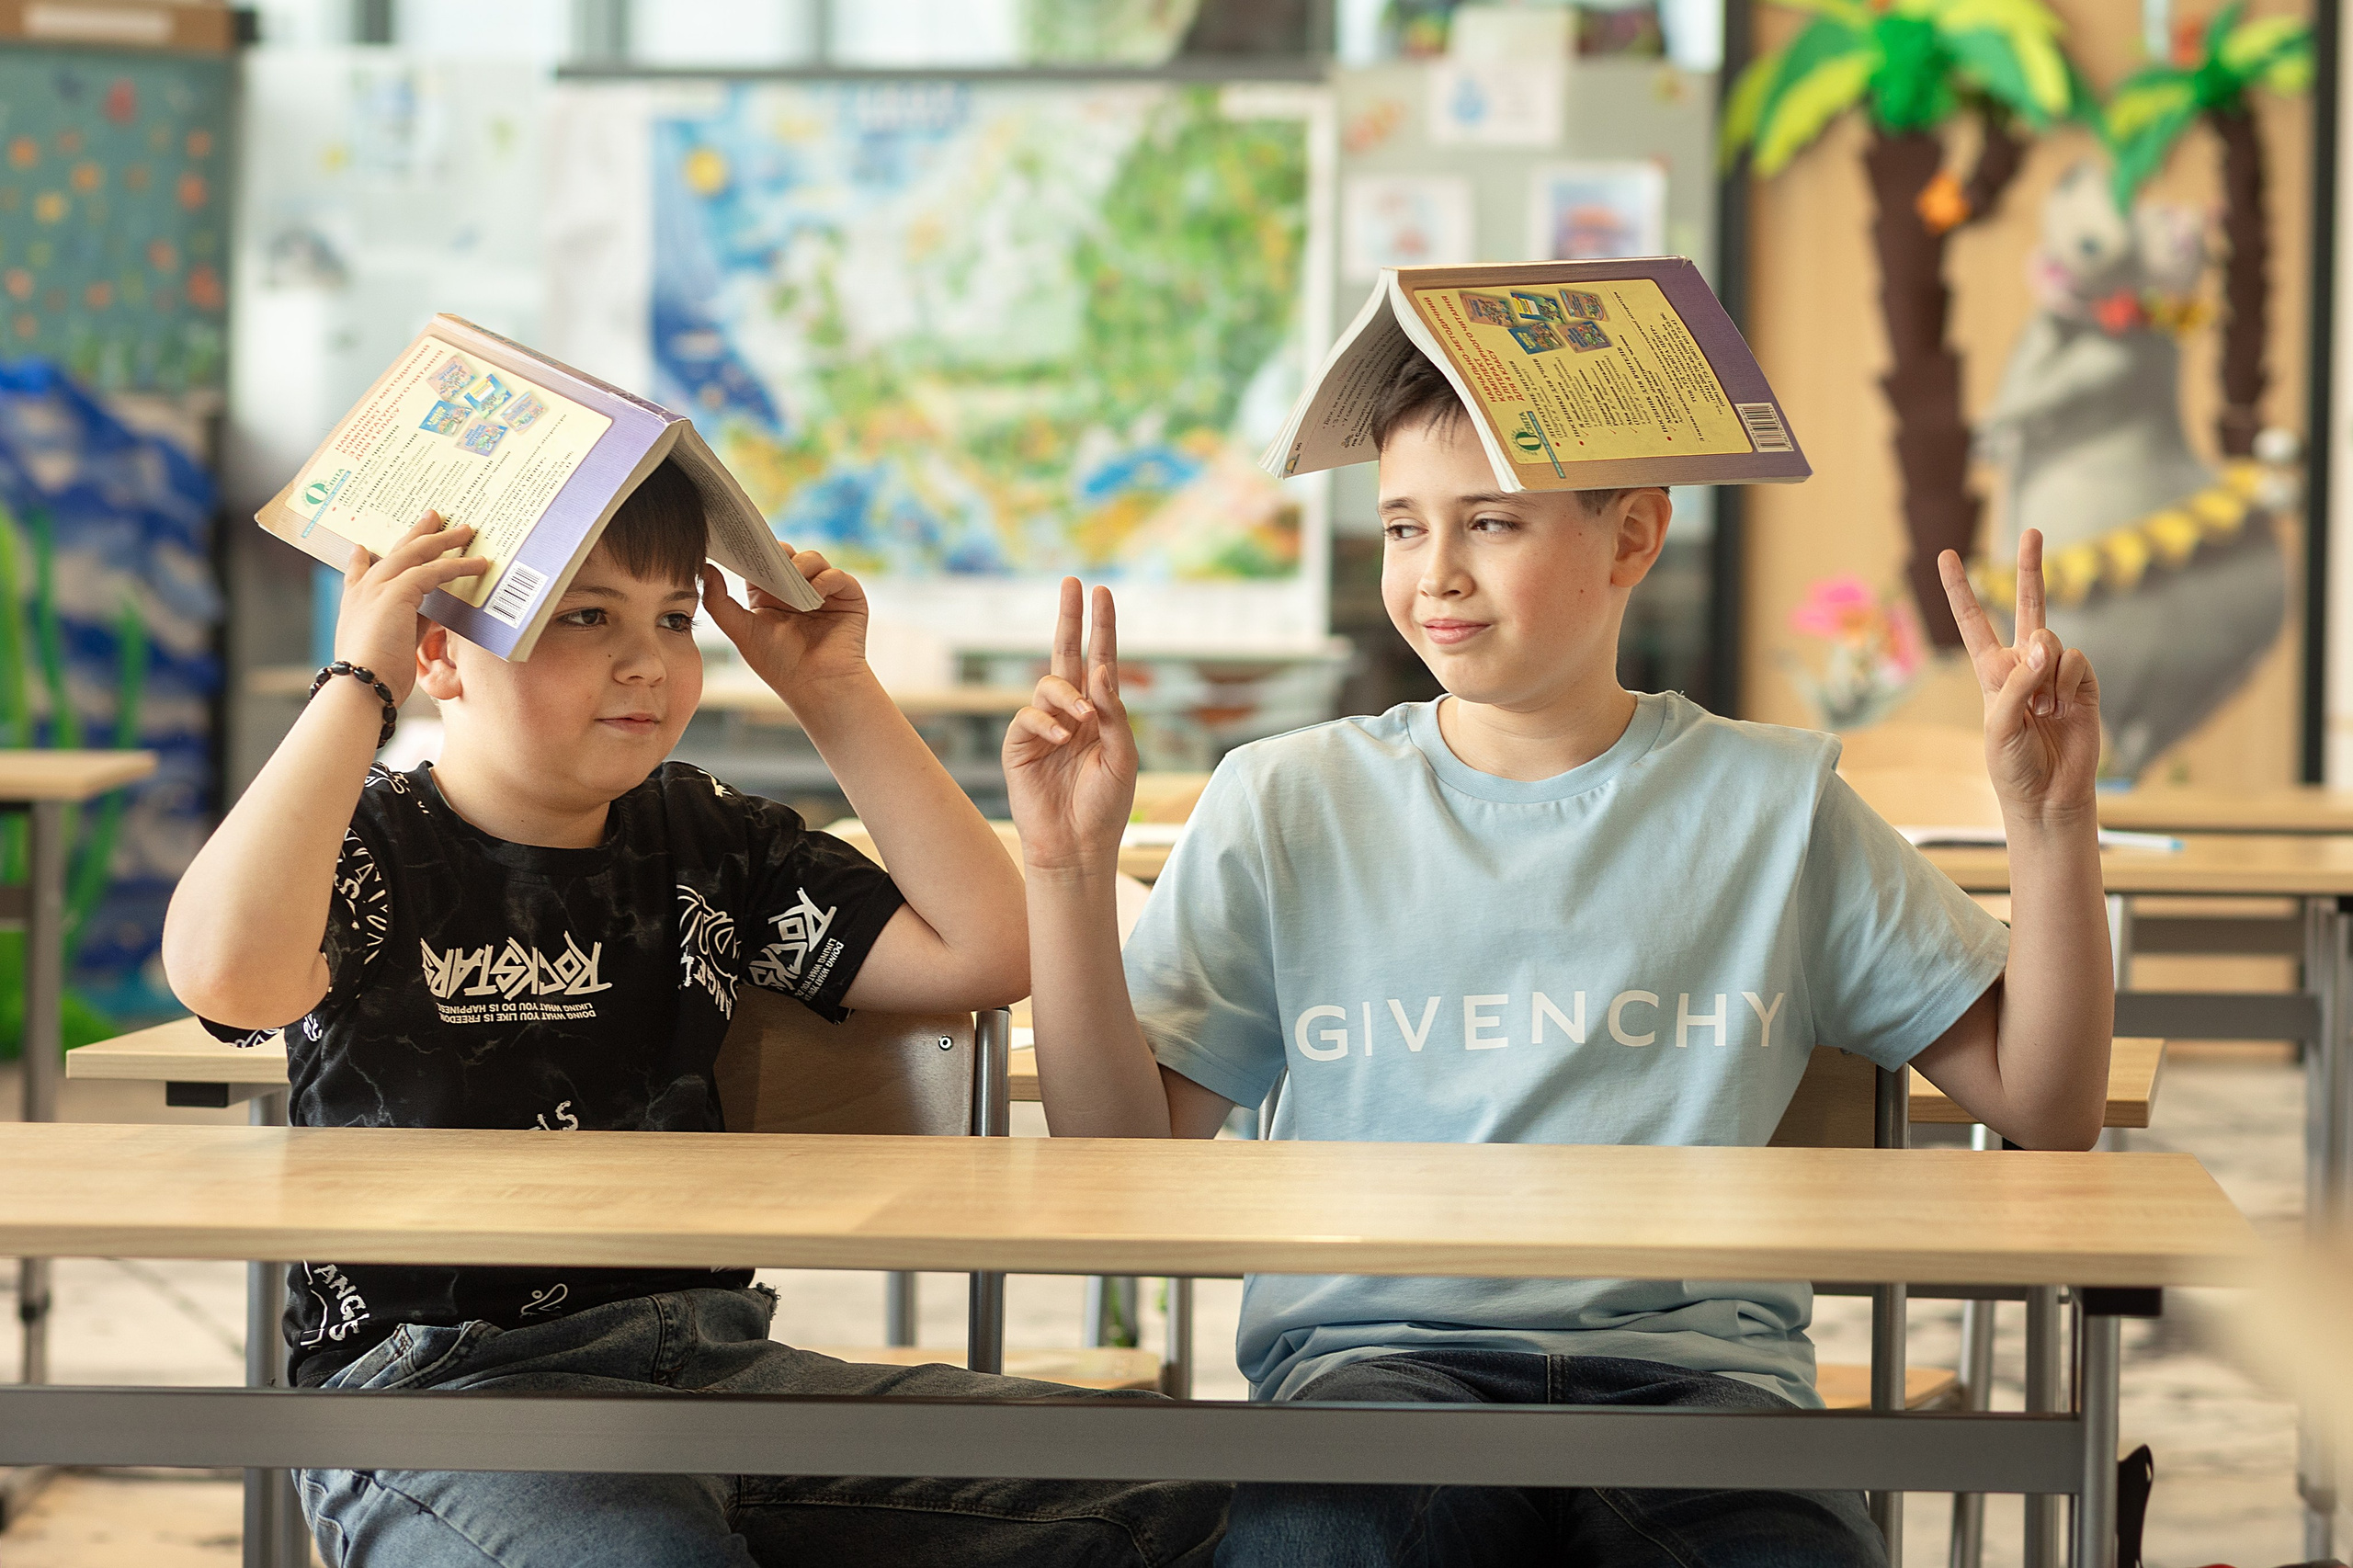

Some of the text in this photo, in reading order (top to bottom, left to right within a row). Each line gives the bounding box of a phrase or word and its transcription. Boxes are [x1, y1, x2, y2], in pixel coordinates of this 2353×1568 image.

[1440, 295, 1469, 331] ЧИТАННЯ
[1423, 296, 1497, 402] НАВЧАЛЬНО-МЕТОДИЧНИЙ
[1464, 332, 1510, 393] ЛІТЕРАТУРНОГО
[1486, 349, 1508, 375] КЛАСУ
[1472, 358, 1506, 402] КОМПЛЕКТ
[1507, 382, 1525, 401] ДЛЯ
[334, 343, 430, 450] НАВЧАЛЬНО-МЕТОДИЧНИЙ
[353, 385, 411, 450] ЛІТЕРАТУРНОГО
[408, 349, 444, 386] ЧИТАННЯ
[340, 408, 381, 453] КОМПЛЕКТ
[354, 441, 372, 460] ДЛЯ
[375, 406, 401, 435] КЛАСУ
[817, 938, 836, 963] LIKING
[825, 941, 844, 967] DOING
[420, 930, 612, 1000] ROCKSTARS
[807, 964, 823, 982] WHAT
[815, 968, 830, 986] WHAT
[483, 1014, 494, 1022] IS
[489, 1004, 499, 1012] IS
[496, 1013, 517, 1021] LIKE
[519, 1003, 539, 1011] YOU
[520, 1012, 540, 1020] YOU
[540, 1003, 563, 1012] WHAT
[541, 1012, 566, 1020] WHAT
[563, 1003, 593, 1012] LIKING
[566, 1010, 597, 1019] DOING
[1294, 990, 1784, 1062] GIVENCHY
